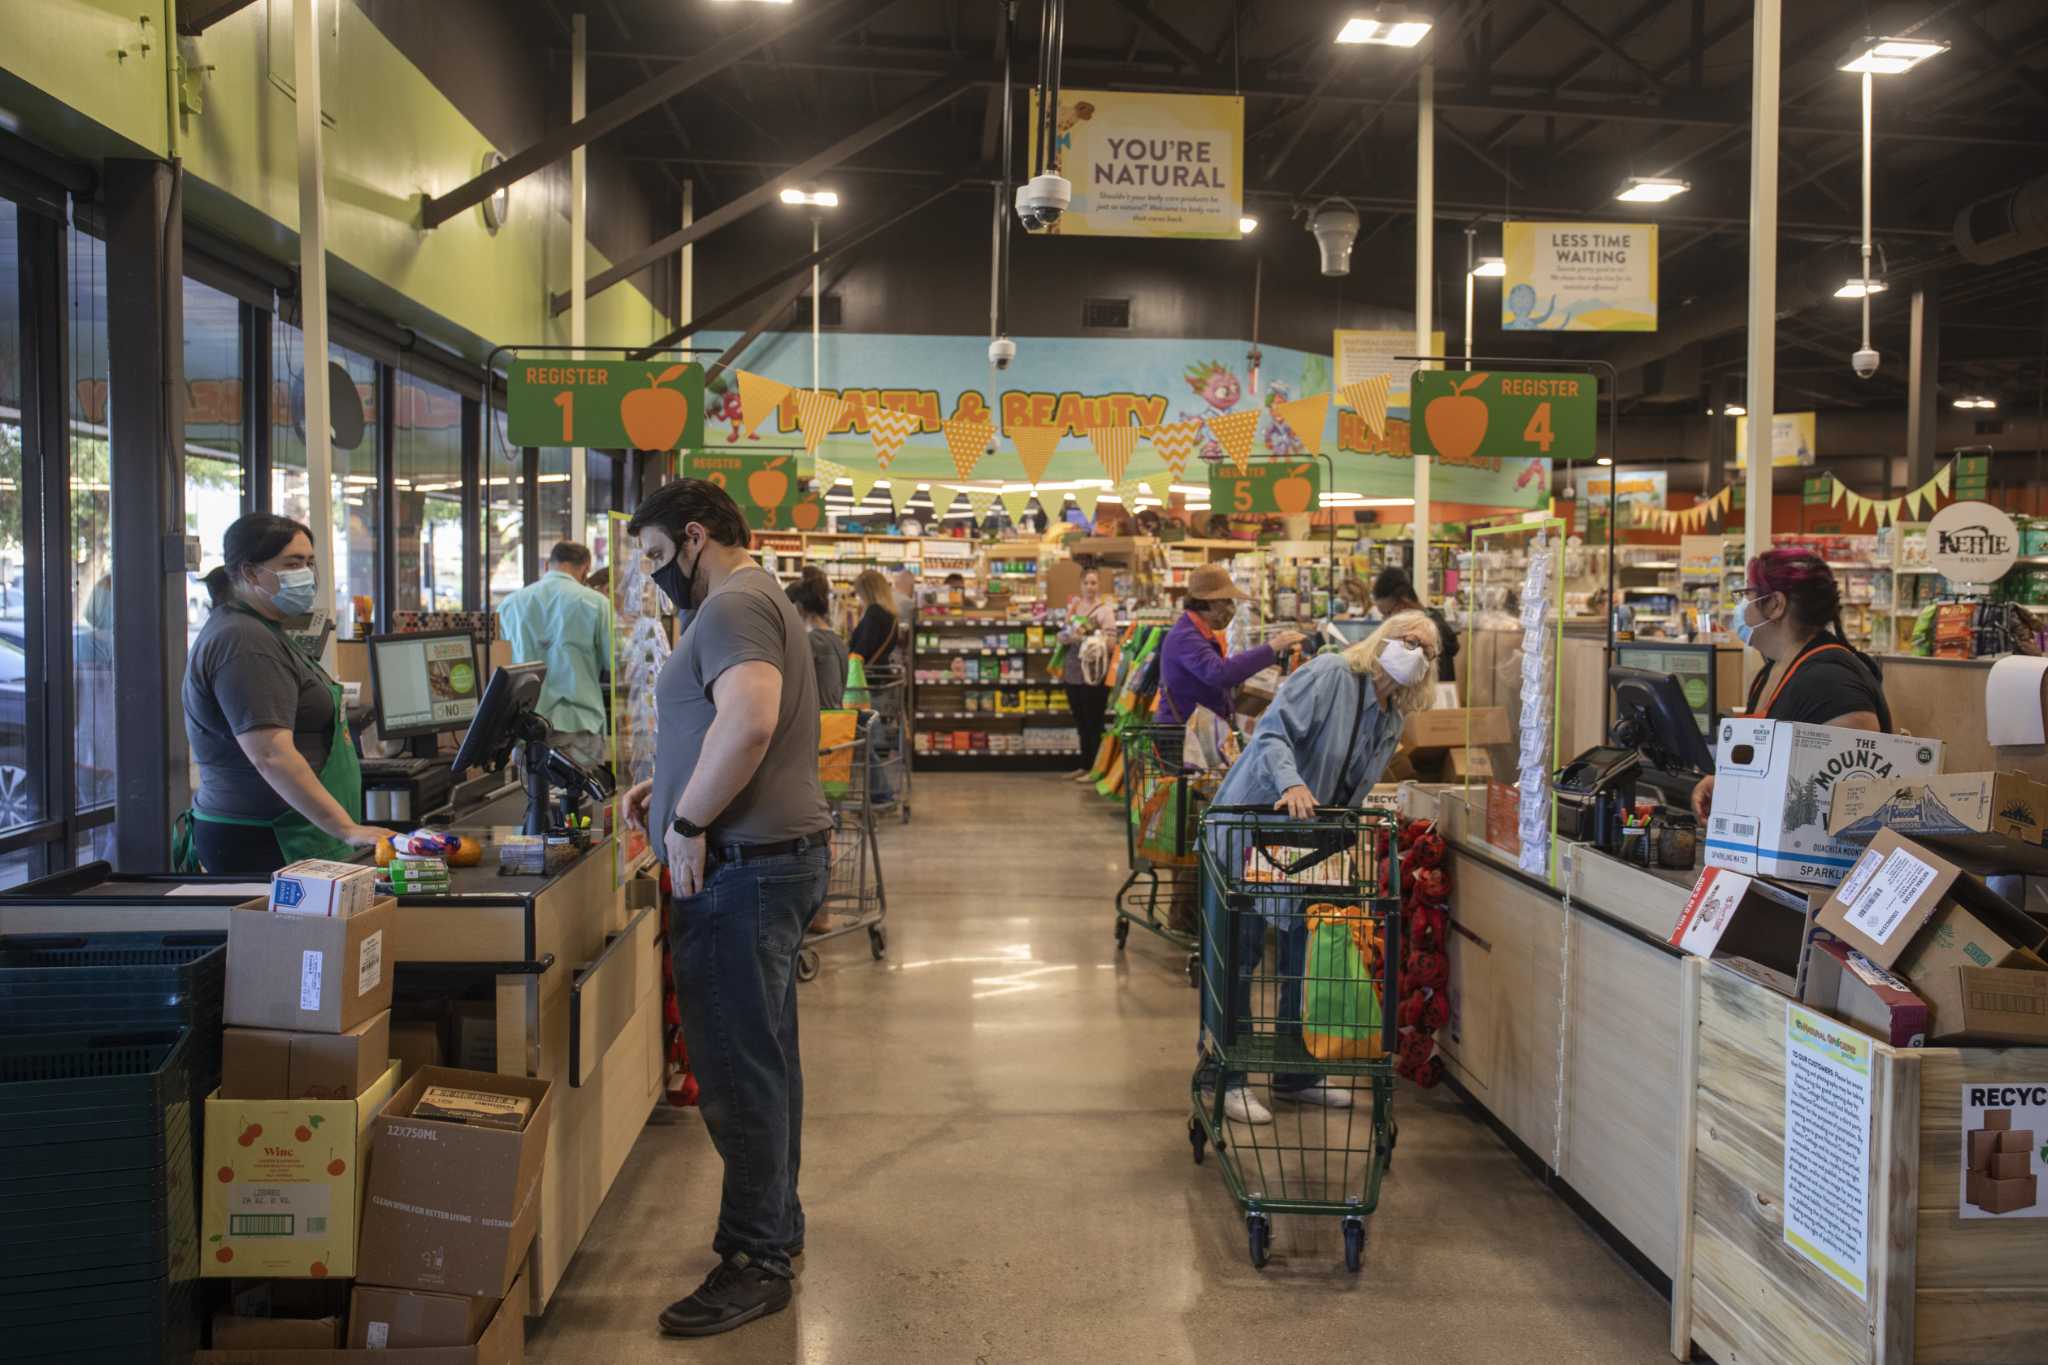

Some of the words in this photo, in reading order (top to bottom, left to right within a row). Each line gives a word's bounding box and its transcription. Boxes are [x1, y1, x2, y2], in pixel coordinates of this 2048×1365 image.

[1107, 138, 1211, 163] YOU'RE
[1094, 163, 1225, 189] NATURAL
[1552, 233, 1589, 248] LESS
[1592, 234, 1632, 248] TIME
[1556, 250, 1626, 264] WAITING
[526, 367, 609, 385] REGISTER
[1501, 379, 1580, 397] REGISTER
[553, 391, 574, 443] 1
[1523, 402, 1555, 452] 4
[692, 457, 742, 470] REGISTER
[1233, 480, 1253, 512] 5
[1856, 738, 1877, 750] THE
[1970, 1087, 2047, 1107] RECYC
[386, 1124, 438, 1141] 12X750ML
[263, 1146, 295, 1157] Wine
